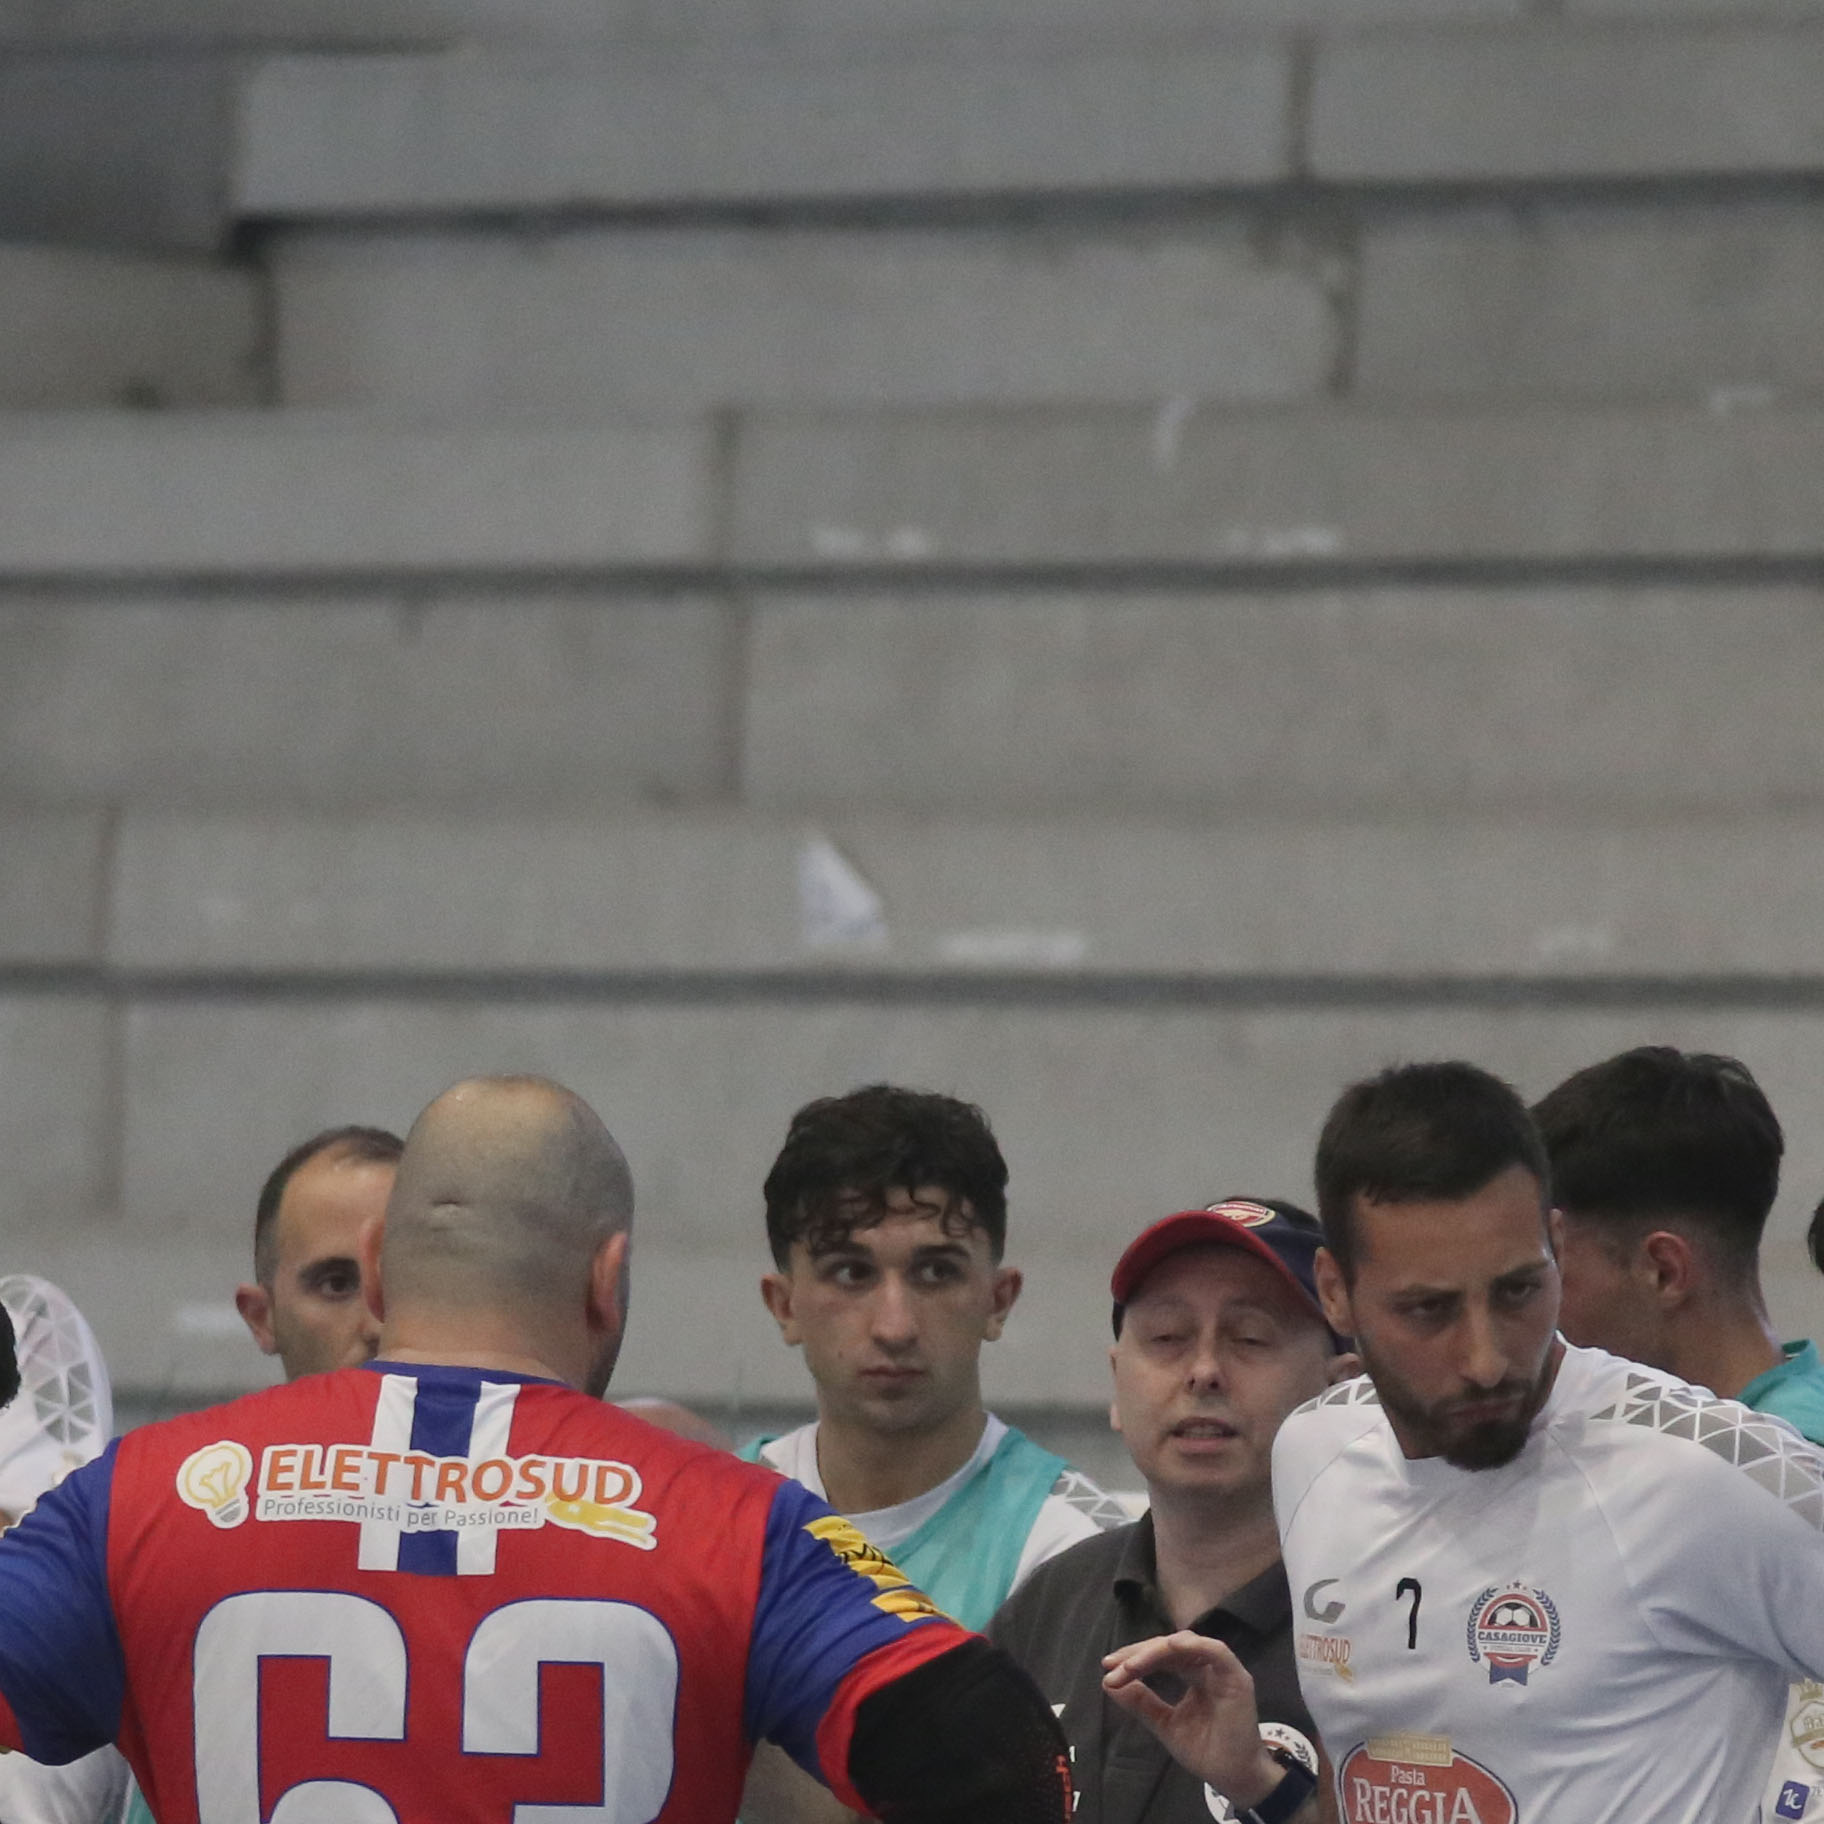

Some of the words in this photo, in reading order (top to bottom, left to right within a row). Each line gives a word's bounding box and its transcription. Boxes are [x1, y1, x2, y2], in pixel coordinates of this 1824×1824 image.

[265, 1449, 633, 1504] ELETTROSUD
[262, 1496, 400, 1522] Professionisti
[406, 1510, 439, 1529] per
[444, 1507, 539, 1528] Passione!
[1395, 1576, 1422, 1650] 7
[1477, 1630, 1548, 1645] CASAGIOVE
[1390, 1765, 1426, 1786] Pasta
